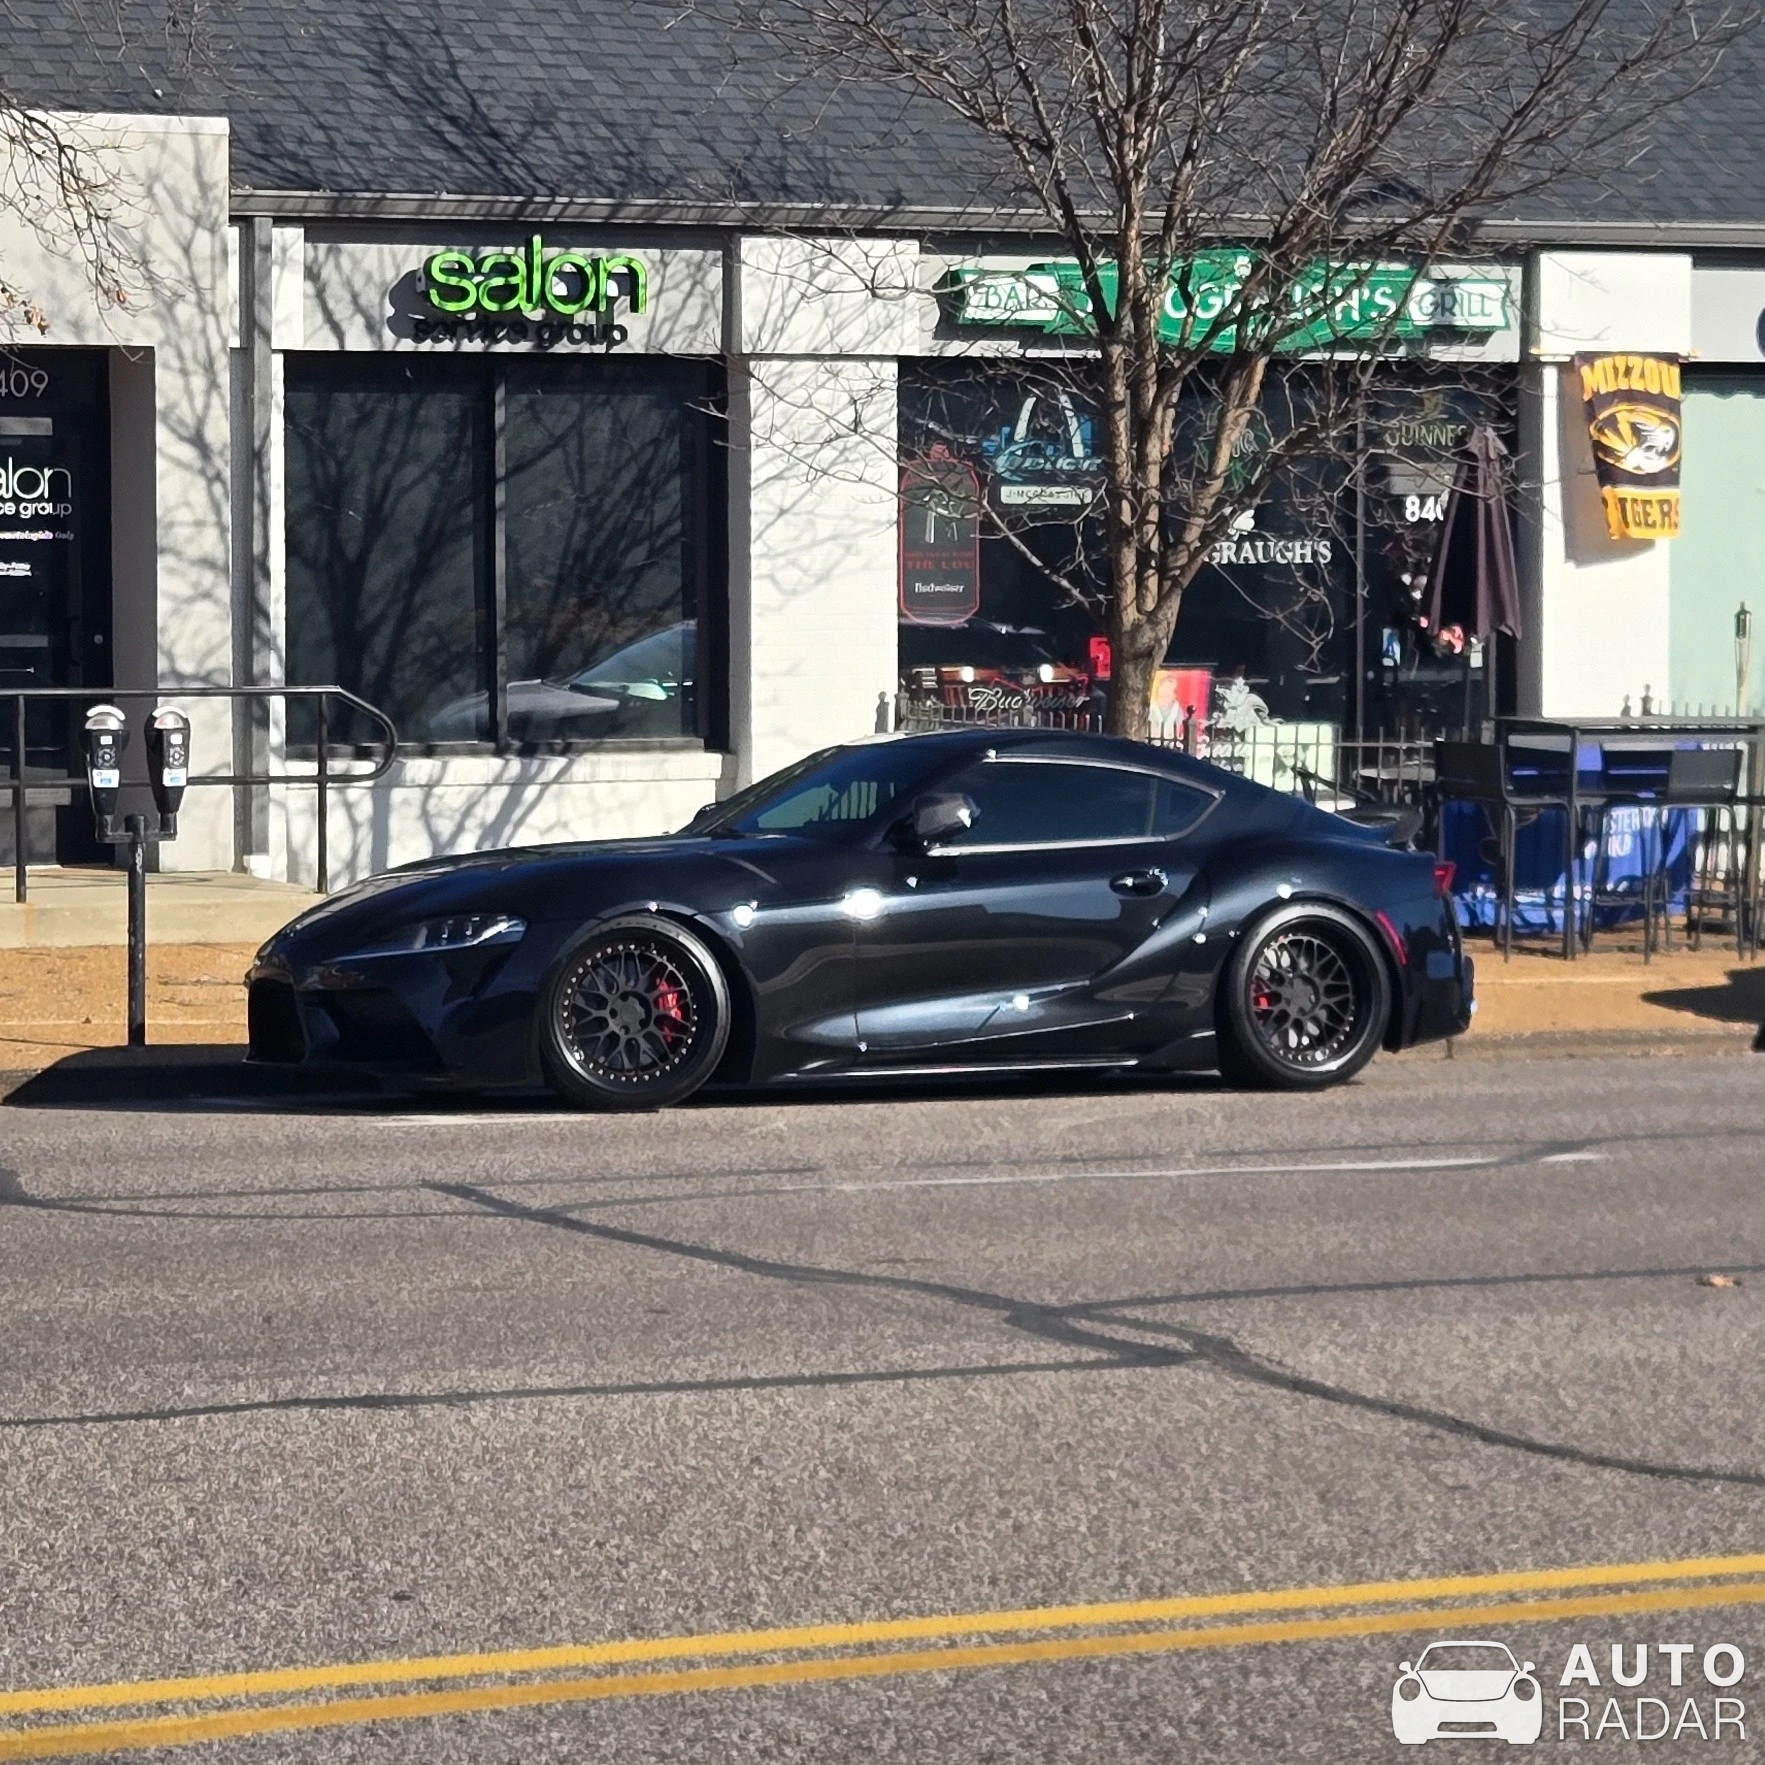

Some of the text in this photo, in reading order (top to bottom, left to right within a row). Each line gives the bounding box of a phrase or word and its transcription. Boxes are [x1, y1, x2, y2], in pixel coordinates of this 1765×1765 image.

[429, 234, 647, 314] salon
[1419, 292, 1493, 320] GRILL
[535, 322, 628, 353] group
[1581, 356, 1681, 401] MIZZOU
[19, 502, 72, 519] group
